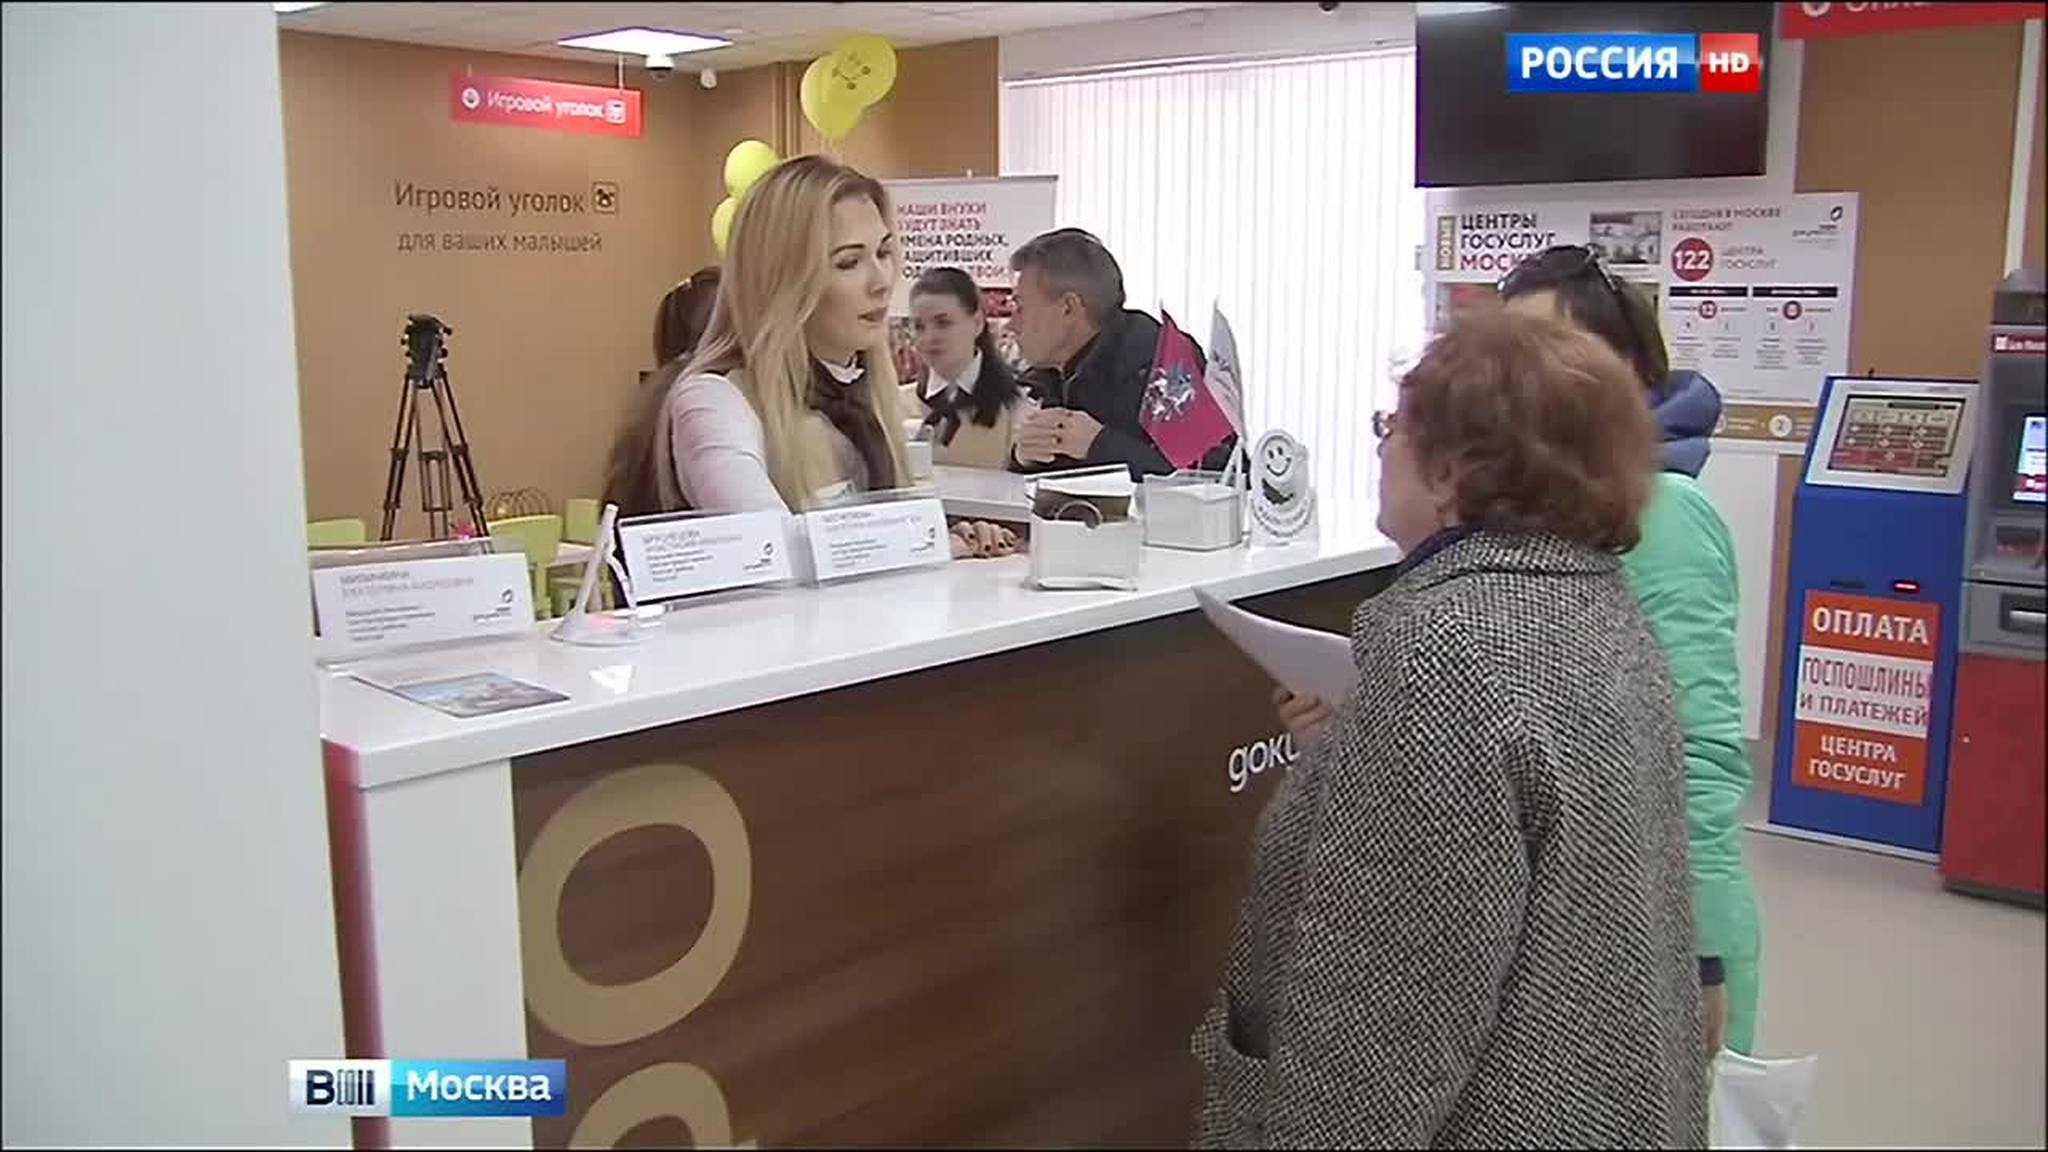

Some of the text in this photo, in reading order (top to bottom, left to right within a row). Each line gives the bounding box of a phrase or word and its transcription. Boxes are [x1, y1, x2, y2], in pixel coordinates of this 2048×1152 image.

[487, 90, 605, 118] Игровой уголок
[395, 181, 584, 217] Игровой уголок
[1461, 213, 1538, 231] ЦЕНТРЫ
[398, 231, 603, 253] для ваших малышей
[1461, 232, 1556, 249] ГОСУСЛУГ
[1674, 249, 1711, 270] 122
[1812, 606, 1929, 645] ОПЛАТА
[1800, 692, 1927, 727] И ПЛАТЕЖЕЙ
[1820, 734, 1896, 762] ЦЕНТРА
[1808, 759, 1906, 790] ГОСУСЛУГ
